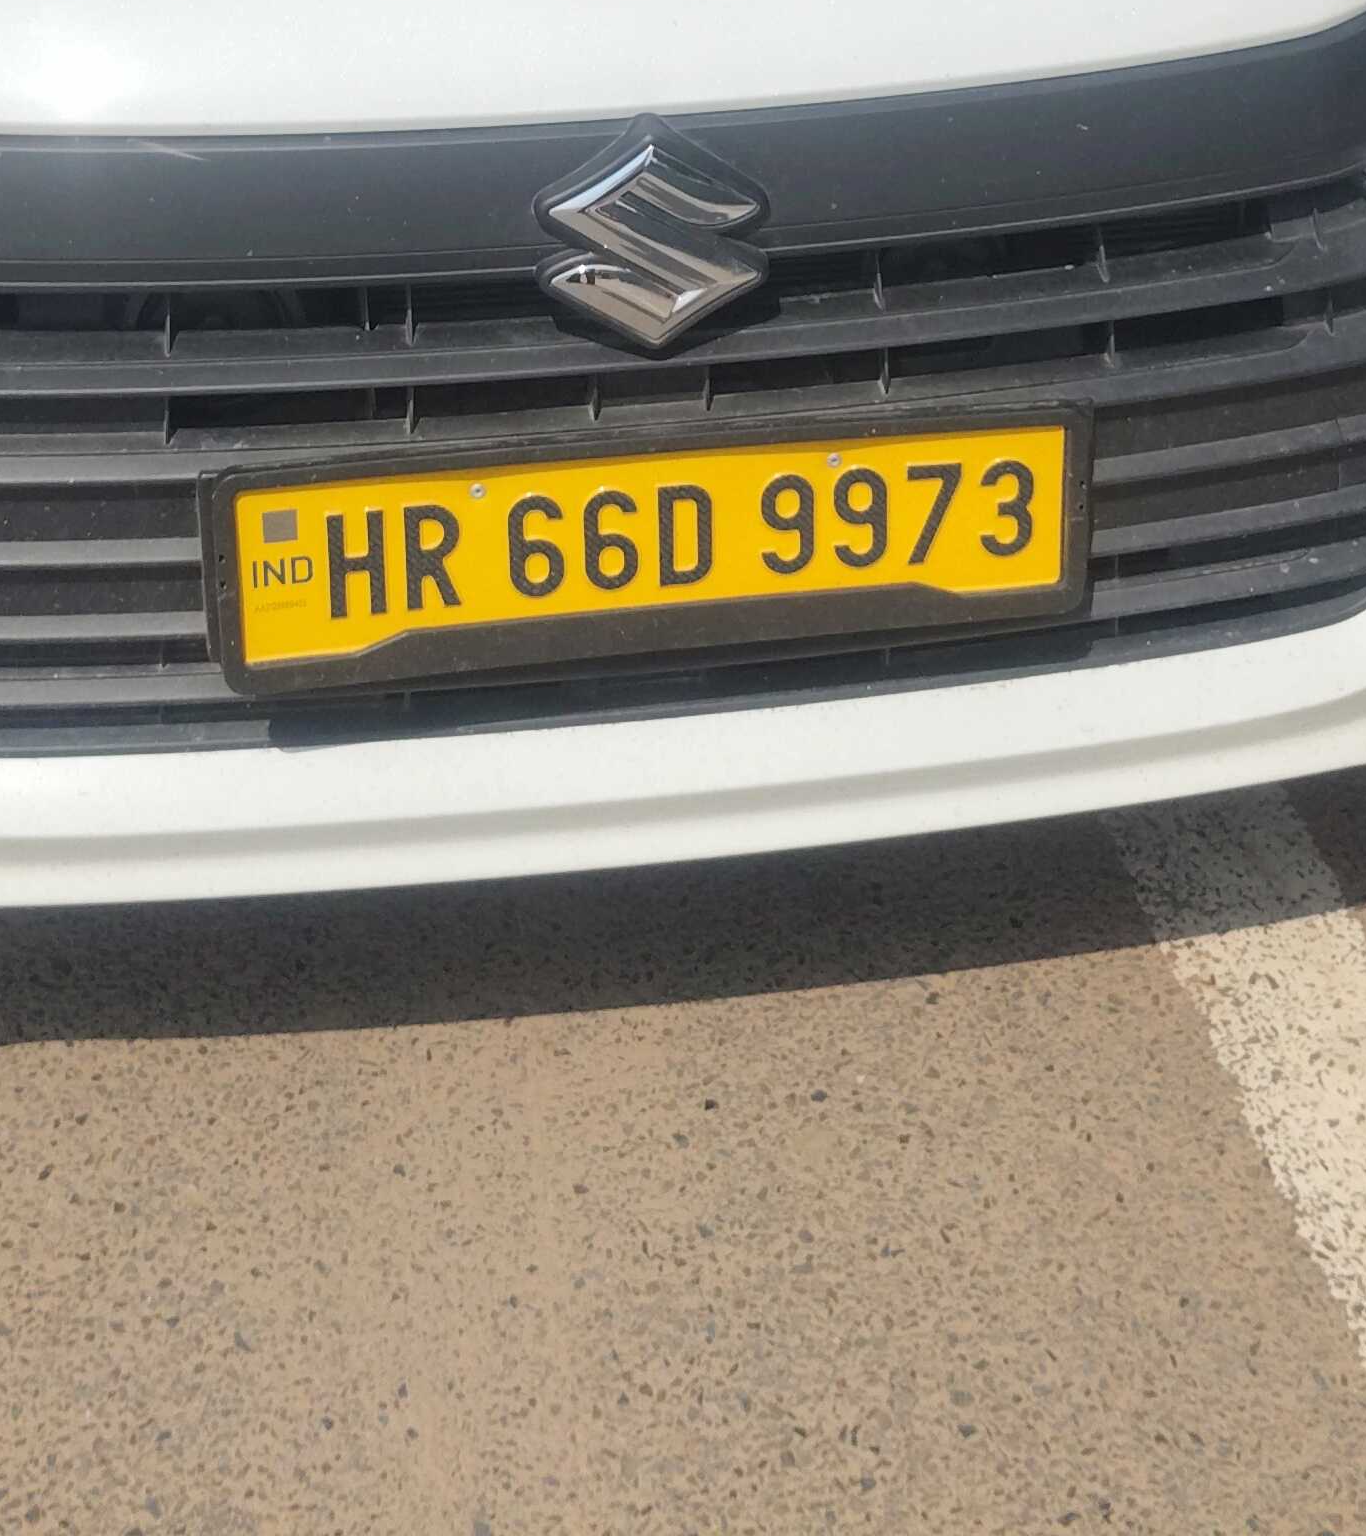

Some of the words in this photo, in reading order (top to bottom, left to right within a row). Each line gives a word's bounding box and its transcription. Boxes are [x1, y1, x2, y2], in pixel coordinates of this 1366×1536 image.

[252, 555, 314, 589] IND
[325, 503, 462, 619] HR
[507, 484, 713, 597] 66D
[760, 459, 1035, 575] 9973
